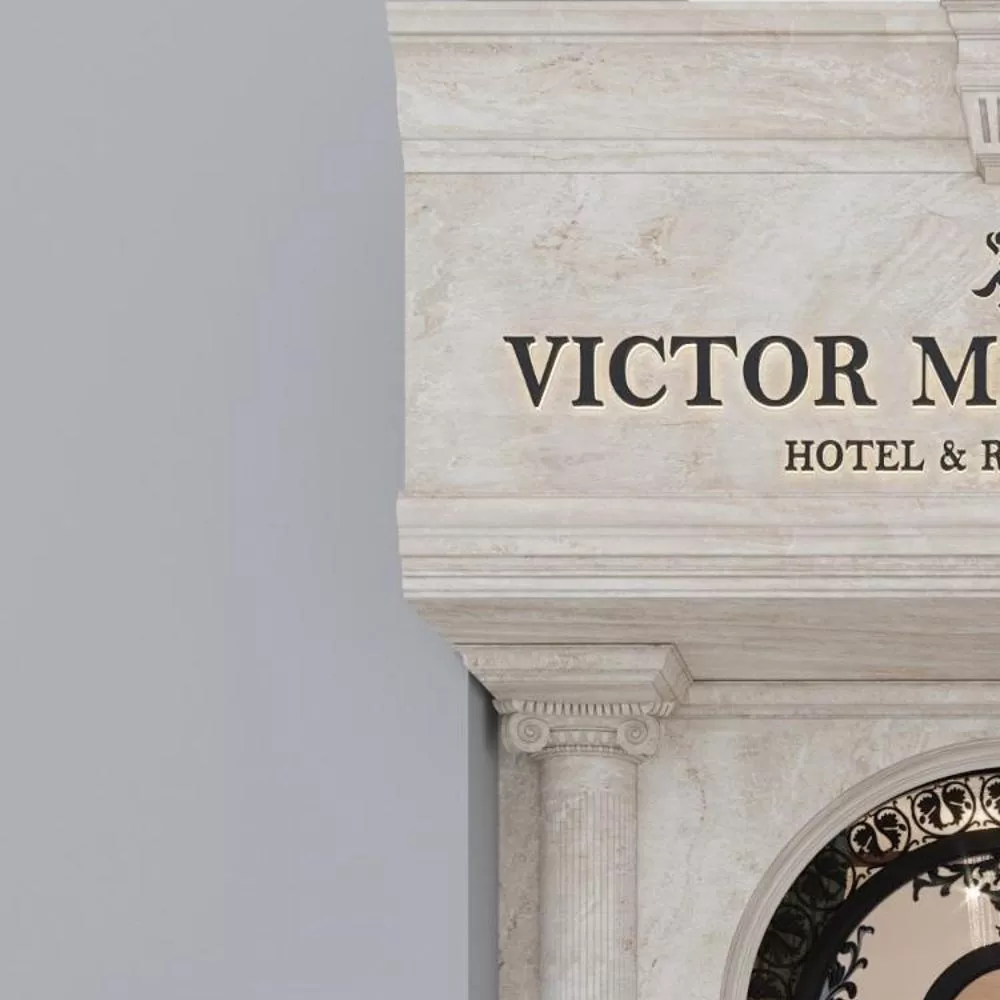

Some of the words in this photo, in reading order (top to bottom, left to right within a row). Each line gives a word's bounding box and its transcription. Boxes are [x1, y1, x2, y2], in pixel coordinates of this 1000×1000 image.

[504, 336, 876, 407] VICTOR
[785, 440, 925, 471] HOTEL
[941, 440, 967, 471] &
